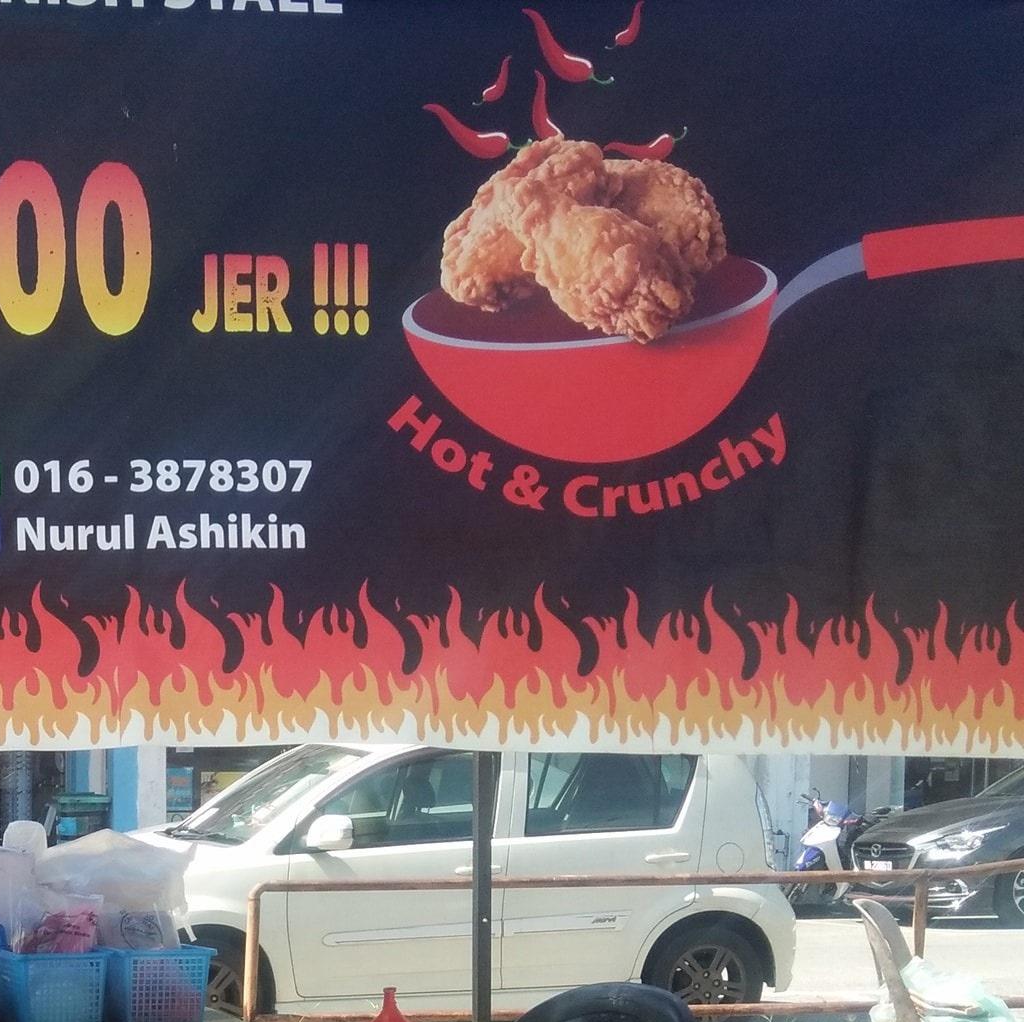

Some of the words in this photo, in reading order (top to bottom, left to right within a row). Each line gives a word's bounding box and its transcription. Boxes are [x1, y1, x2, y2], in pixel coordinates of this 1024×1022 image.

[192, 254, 292, 332] JER
[314, 243, 370, 335] !!!
[14, 459, 94, 493] 016
[129, 459, 313, 493] 3878307
[387, 394, 494, 490] Hot
[502, 464, 549, 511] &
[563, 412, 787, 518] Crunchy
[16, 514, 135, 551] Nurul
[146, 513, 306, 549] Ashikin
